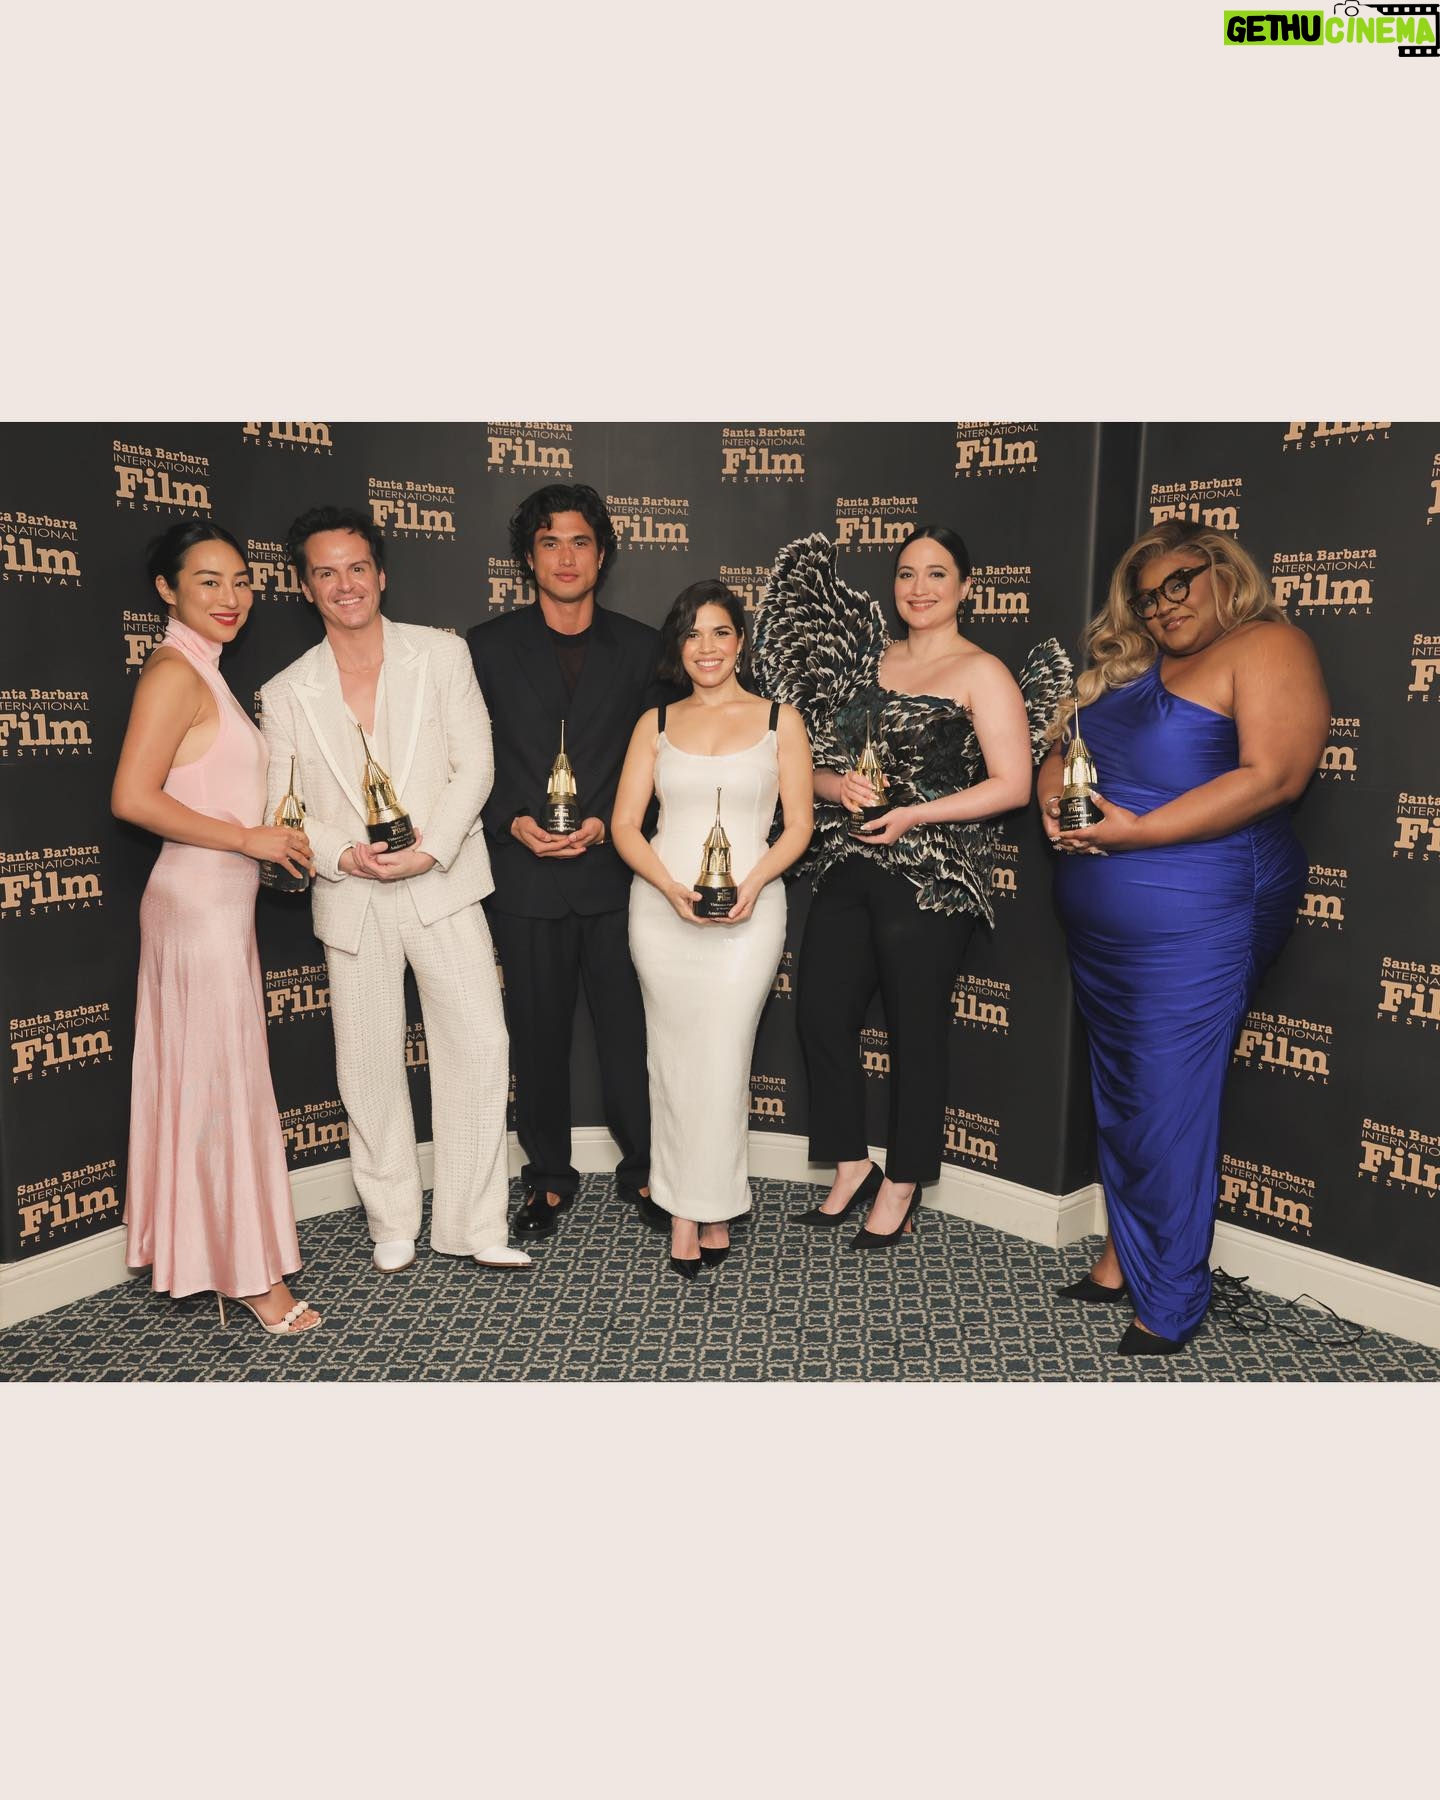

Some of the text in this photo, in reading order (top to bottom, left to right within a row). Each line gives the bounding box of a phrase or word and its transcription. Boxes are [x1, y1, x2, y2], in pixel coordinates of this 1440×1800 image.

[488, 427, 572, 440] INTERNATIONAL
[723, 428, 805, 437] Santa Barbara
[956, 424, 1038, 439] INTERNATIONAL
[243, 437, 333, 456] FESTIVAL
[722, 438, 805, 446] INTERNATIONAL
[1283, 432, 1390, 451] FESTIVAL
[113, 440, 209, 466] Santa Barbara
[488, 437, 573, 469] Film
[722, 446, 805, 474] Film
[956, 437, 1037, 469] Film
[113, 454, 210, 477] INTERNATIONAL
[488, 466, 573, 477] FESTIVAL
[955, 466, 1037, 478] FESTIVAL
[115, 465, 211, 509] Film
[369, 478, 454, 494] Santa Barbara
[1151, 478, 1242, 494] Santa Barbara
[369, 489, 454, 503] INTERNATIONAL
[606, 495, 689, 506] Santa Barbara
[837, 496, 918, 506] Santa Barbara
[1150, 489, 1241, 504] INTERNATIONAL
[117, 501, 212, 519] FESTIVAL
[369, 499, 455, 532] Film
[836, 507, 917, 515] INTERNATIONAL
[16, 512, 77, 530] Barbara
[608, 515, 689, 543] Film
[836, 516, 914, 544] Film
[0, 524, 78, 541] RNATIONAL
[381, 530, 455, 541] ESTIVAL
[248, 539, 283, 552] Santa
[0, 534, 81, 576] ilm
[1273, 549, 1376, 563] Santa Barbara
[720, 566, 752, 575] Santa
[986, 565, 1031, 575] Barbara
[1272, 561, 1375, 574] INTERNATIONAL
[3, 573, 81, 586] STIVAL
[249, 562, 301, 593] Fil
[972, 576, 1030, 584] RNATIONAL
[489, 577, 535, 604] Fil
[1272, 573, 1373, 606] Film
[968, 585, 1029, 615] ilm
[123, 610, 160, 622] Santa
[1282, 607, 1371, 616] ESTIVAL
[1413, 634, 1440, 645] San
[0, 689, 88, 700] nta Barbara
[0, 702, 90, 710] TERNATIONAL
[3, 748, 92, 756] ESTIVAL
[0, 846, 100, 863] Santa Barbara
[1, 856, 100, 874] NTERNATIONAL
[1309, 865, 1347, 878] rbara
[0, 871, 102, 908] Film
[1, 900, 103, 919] FESTIVAL
[266, 968, 298, 980] Santa
[1383, 957, 1426, 973] Santa
[266, 974, 329, 989] INTERNATIO
[968, 975, 1010, 991] Barbara
[1381, 969, 1440, 986] INTERNA
[954, 983, 1010, 999] RNATIONAL
[1378, 980, 1440, 1020] Fil
[10, 1003, 109, 1030] Santa Barbara
[268, 1010, 326, 1026] FESTIV
[951, 991, 1009, 1027] ilm
[10, 1013, 110, 1040] INTERNATIONAL
[953, 1019, 1008, 1035] STIVAL
[1278, 1015, 1332, 1034] Barbara
[1377, 1012, 1438, 1030] FESTI
[1245, 1020, 1331, 1044] TERNATIONAL
[11, 1030, 112, 1073] Film
[1234, 1030, 1329, 1075] Film
[14, 1055, 112, 1084] FESTIVAL
[1234, 1058, 1328, 1084] FESTIVAL
[751, 1075, 786, 1084] arbara
[279, 1108, 301, 1119] anta
[280, 1108, 344, 1127] TERNATIONA
[958, 1108, 1000, 1127] Barbara
[945, 1115, 999, 1135] RNATIONAL
[1363, 1118, 1404, 1137] Santa
[293, 1144, 340, 1159] STIVA
[944, 1124, 998, 1161] ilm
[1362, 1130, 1440, 1156] INTERNATIO
[944, 1150, 996, 1169] STIVAL
[17, 1160, 116, 1195] Santa Barbara
[1223, 1154, 1315, 1188] Santa Barbara
[18, 1170, 117, 1206] INTERNATIONAL
[1222, 1165, 1314, 1198] INTERNATIONAL
[1358, 1172, 1435, 1198] FESTIV
[1220, 1175, 1312, 1227] Film
[19, 1187, 119, 1237] Film
[1220, 1203, 1311, 1236] FESTIVAL
[20, 1209, 119, 1246] FESTIVAL
